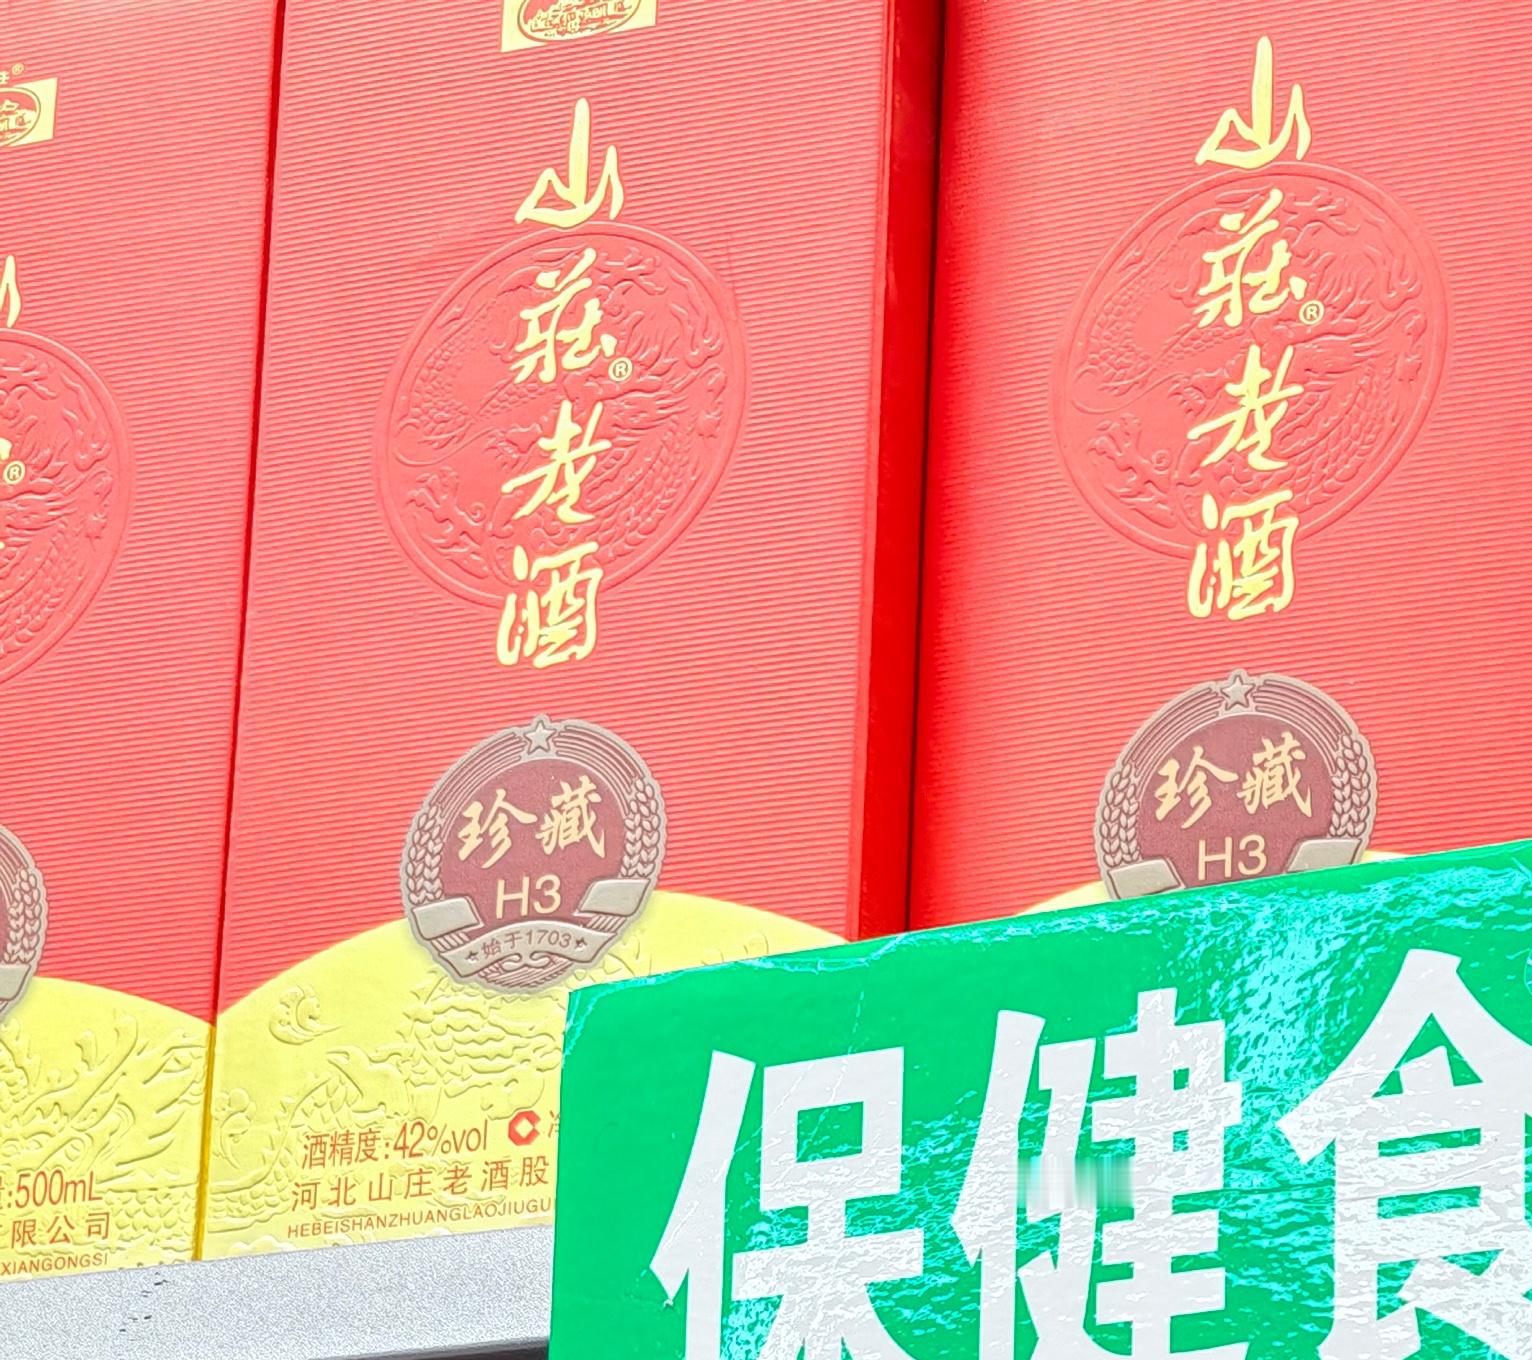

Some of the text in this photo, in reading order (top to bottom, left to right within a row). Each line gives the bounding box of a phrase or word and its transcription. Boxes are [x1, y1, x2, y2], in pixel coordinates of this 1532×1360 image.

[1154, 731, 1313, 828] 珍藏
[457, 775, 606, 869] 珍藏
[1198, 832, 1269, 881] H3
[496, 873, 562, 919] H3
[481, 928, 573, 959] 始于1703
[291, 1155, 551, 1211] 河北山庄老酒股
